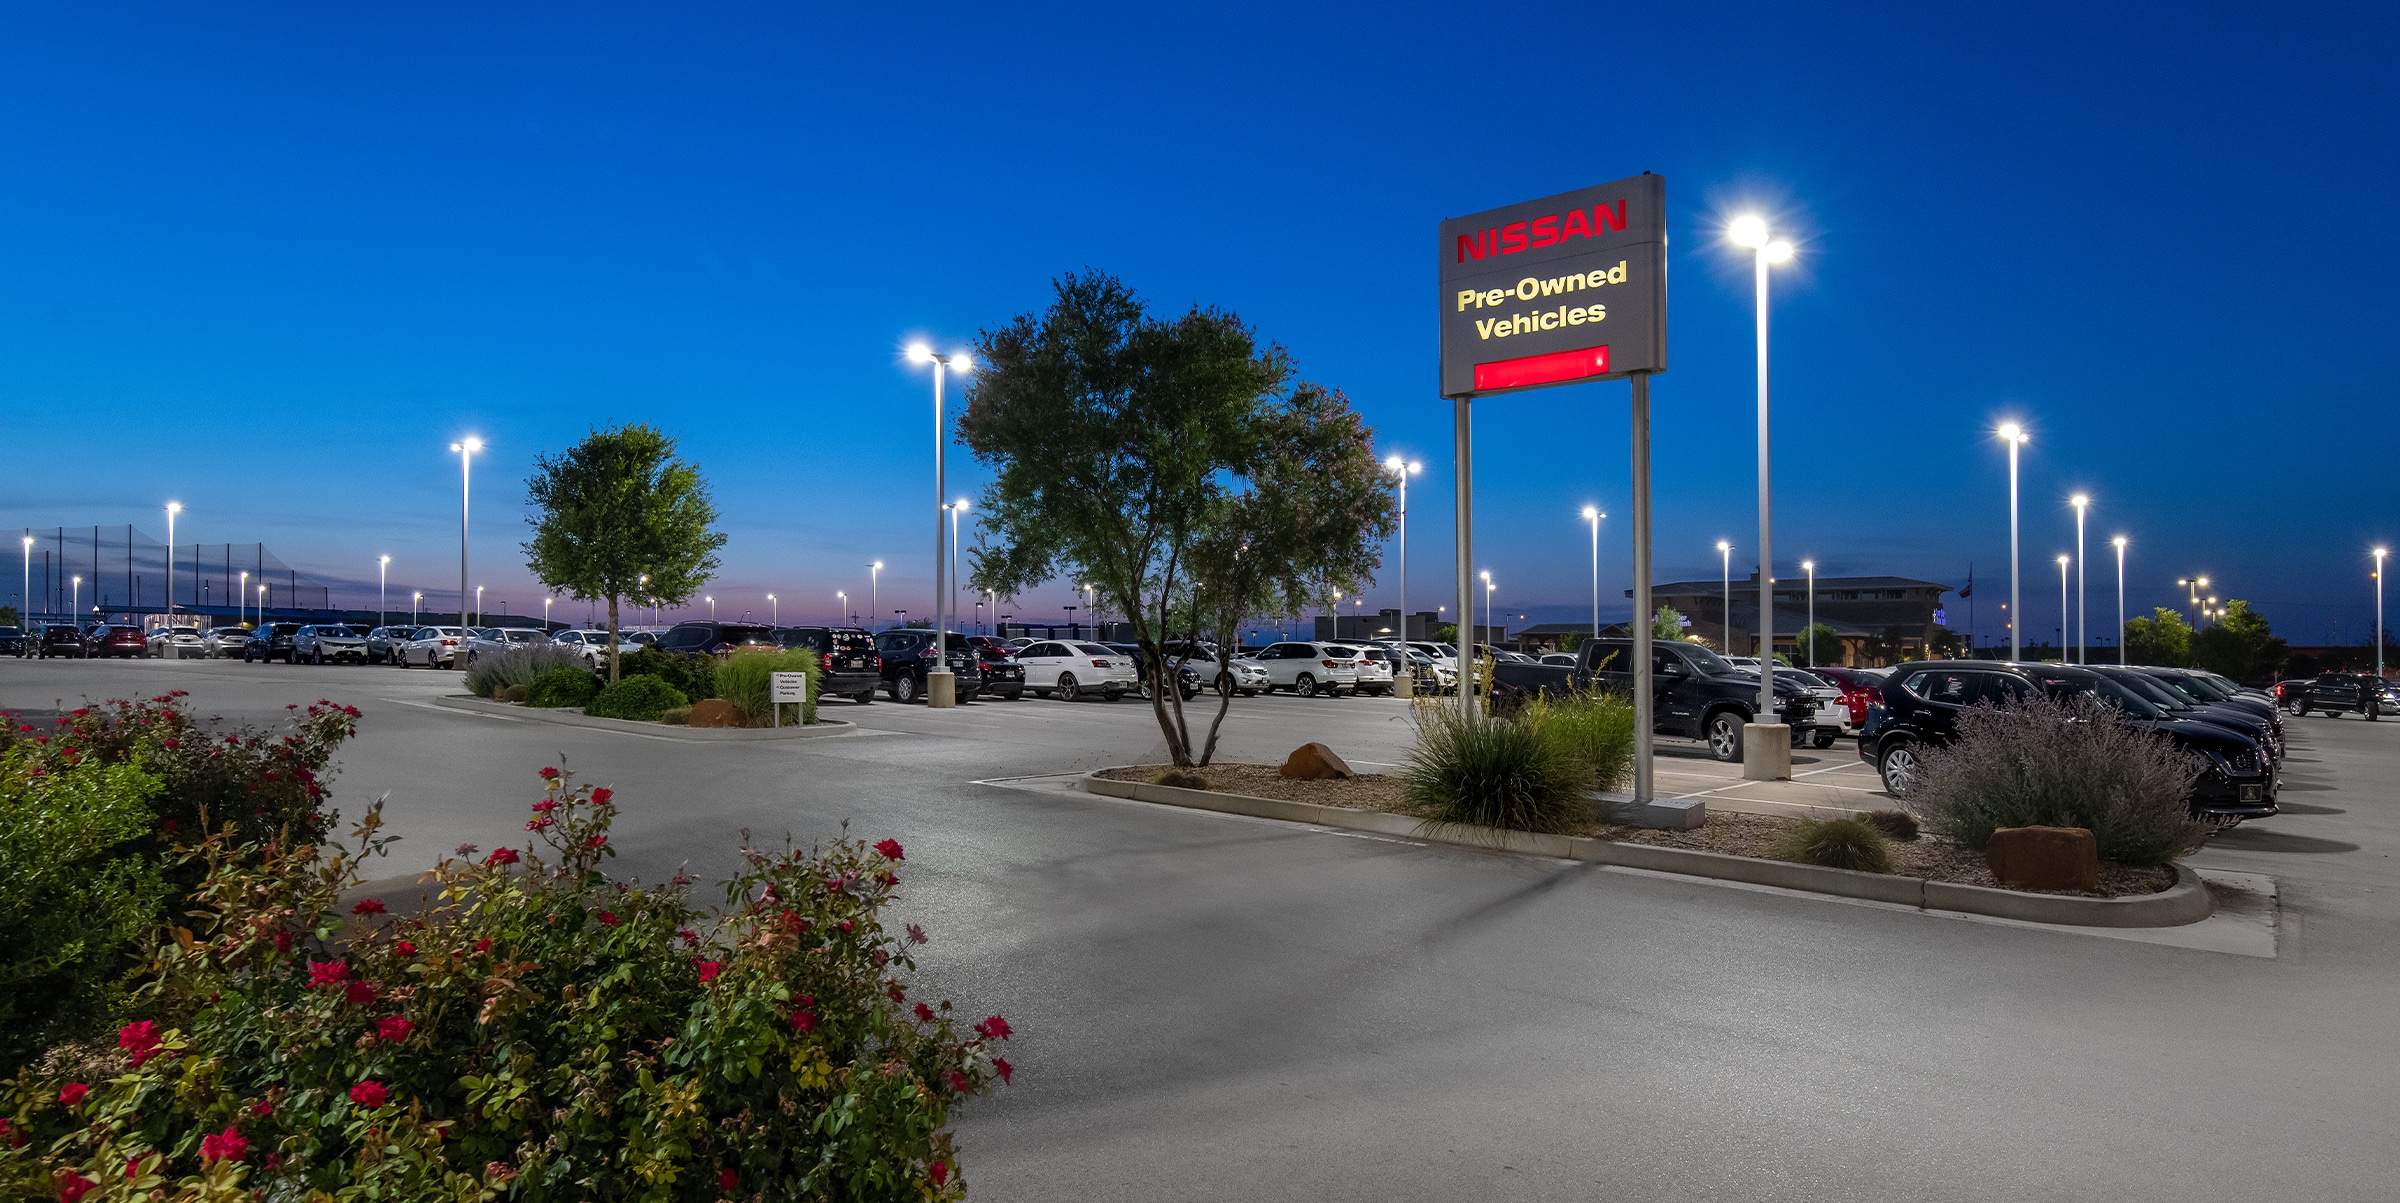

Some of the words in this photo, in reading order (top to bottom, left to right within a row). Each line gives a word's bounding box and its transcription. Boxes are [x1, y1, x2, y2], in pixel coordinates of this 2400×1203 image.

[1457, 199, 1627, 264] NISSAN
[1457, 260, 1627, 312] Pre-Owned
[1475, 303, 1606, 341] Vehicles
